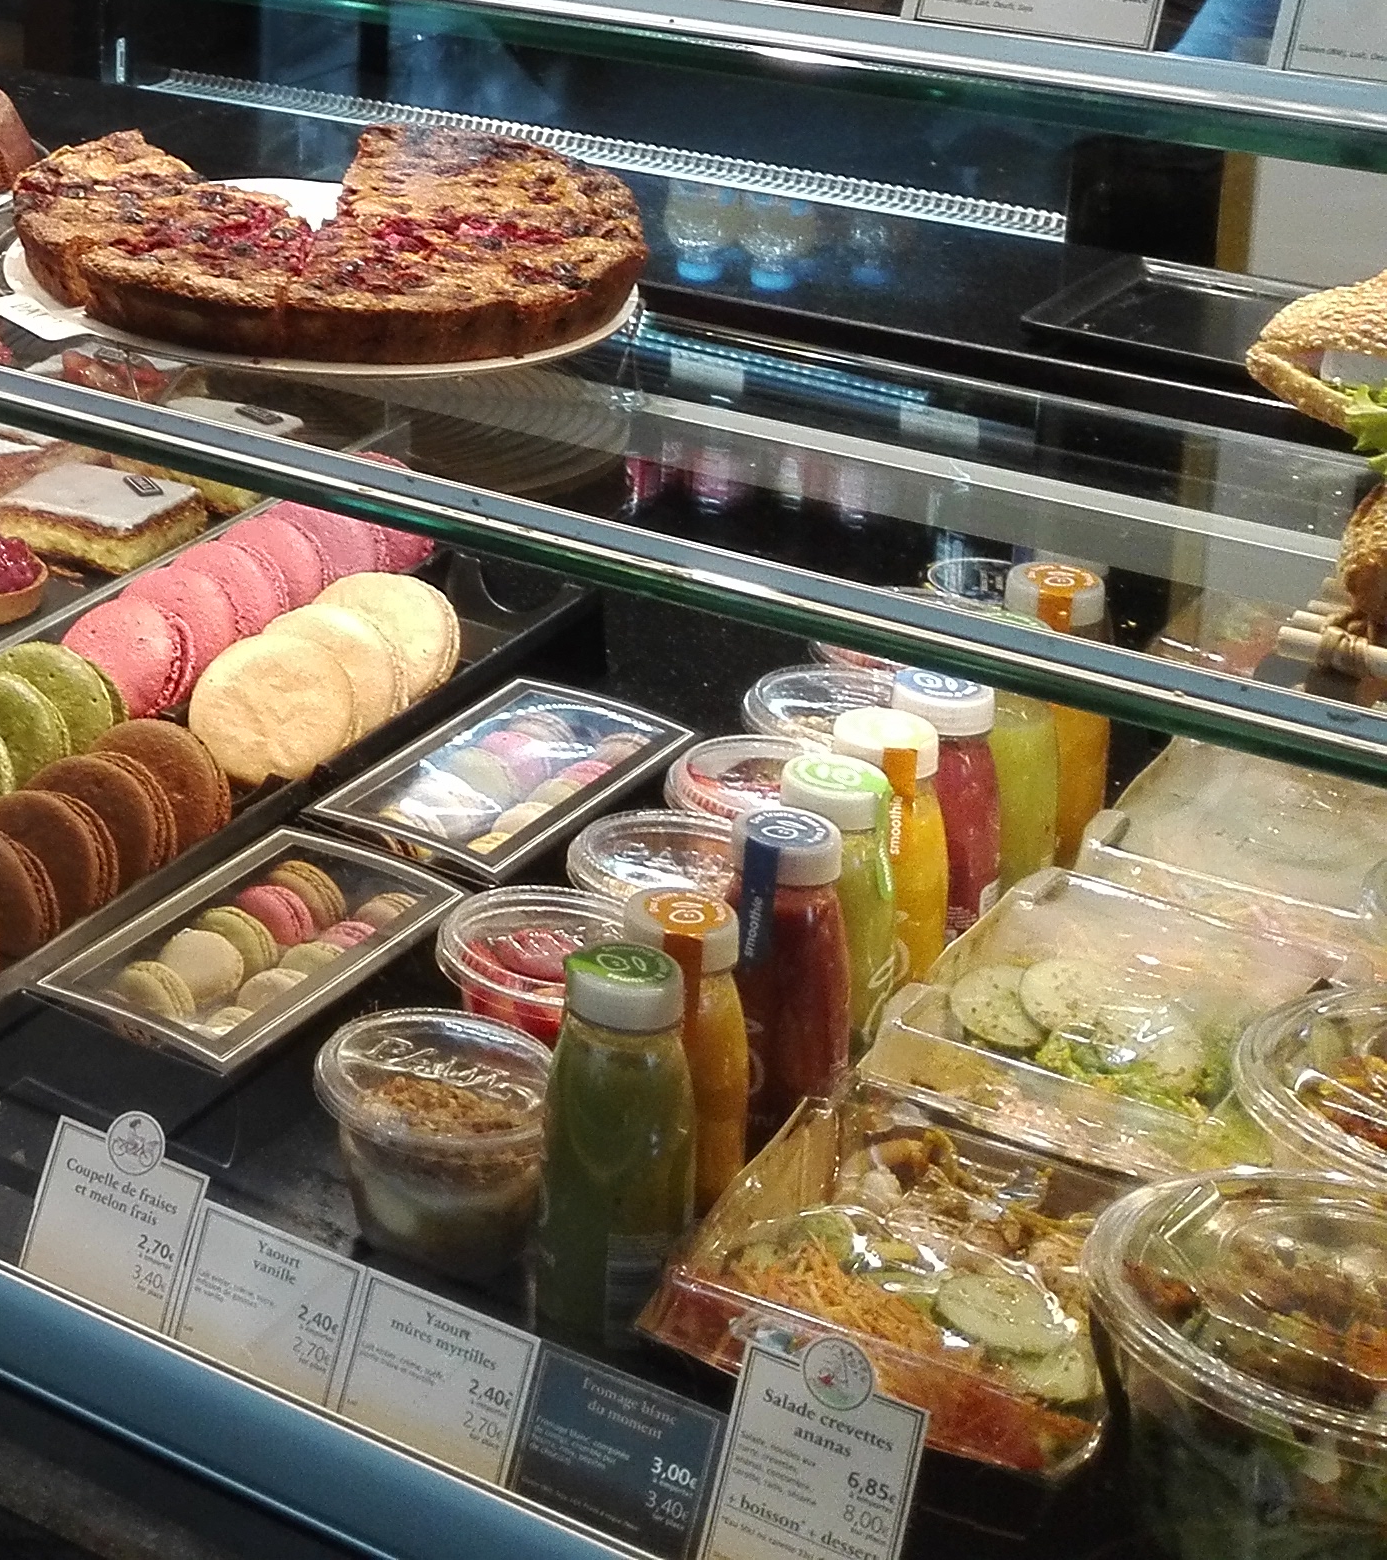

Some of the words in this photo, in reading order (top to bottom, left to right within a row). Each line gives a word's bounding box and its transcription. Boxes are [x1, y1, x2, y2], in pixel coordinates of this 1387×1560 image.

[888, 794, 904, 857] smoothie
[66, 1156, 120, 1189] Coupelle
[121, 1181, 137, 1197] de
[138, 1187, 179, 1215] fraises
[74, 1183, 87, 1196] et
[88, 1190, 128, 1214] melon
[129, 1203, 159, 1226] frais
[137, 1233, 175, 1263] 2,70€
[257, 1239, 301, 1269] Yaourt
[252, 1258, 298, 1285] vanille
[297, 1303, 339, 1336] 2,40€
[426, 1311, 472, 1341] Yaourt
[292, 1336, 332, 1365] 2,70€
[390, 1318, 433, 1345] mûres
[435, 1338, 498, 1372] myrtilles
[468, 1377, 514, 1411] 2,40€
[582, 1377, 641, 1411] Fromage
[641, 1400, 678, 1427] blanc
[462, 1409, 503, 1439] 2,70€
[587, 1399, 606, 1416] du
[607, 1408, 664, 1441] moment
[762, 1387, 817, 1421] Salade
[819, 1414, 895, 1454] crevettes
[793, 1425, 853, 1458] ananas
[650, 1455, 698, 1490] 3,00€
[846, 1470, 897, 1504] 6,85€
[644, 1489, 690, 1521] 3,40€
[842, 1503, 891, 1536] 8,00€
[820, 1530, 880, 1560] dessert
